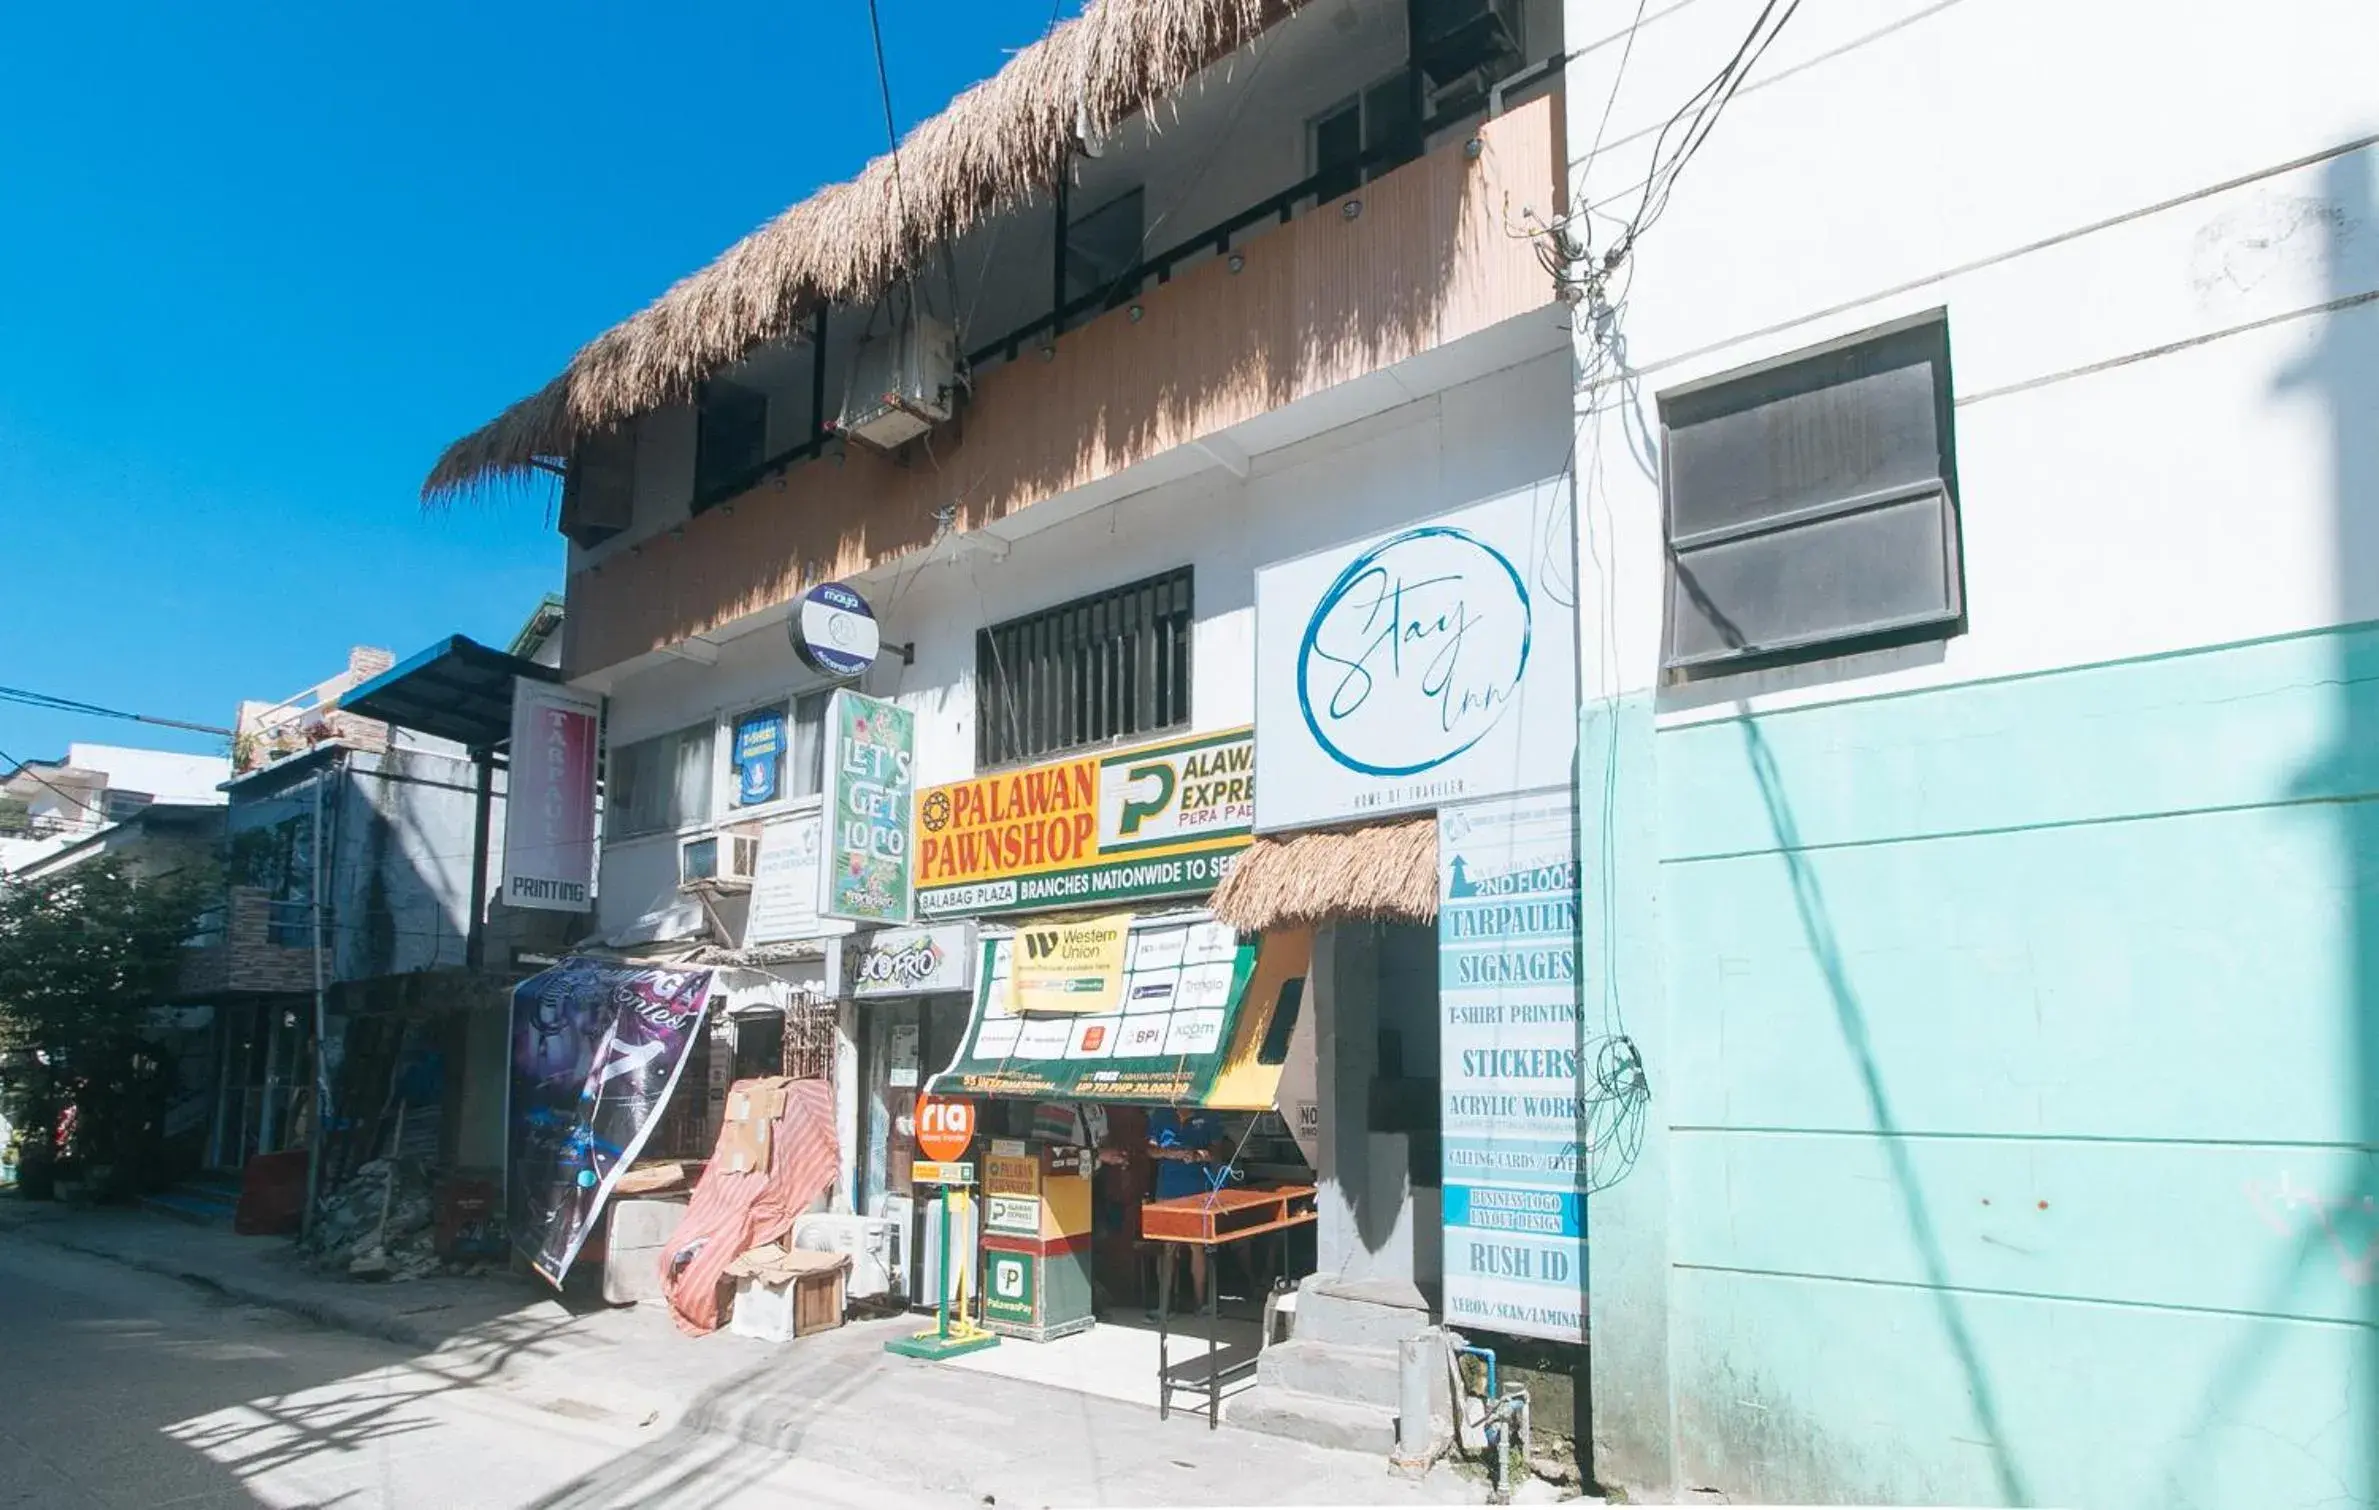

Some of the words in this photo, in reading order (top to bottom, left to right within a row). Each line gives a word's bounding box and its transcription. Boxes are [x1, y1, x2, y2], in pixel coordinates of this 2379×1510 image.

[824, 589, 859, 609] maya
[1314, 567, 1482, 719] Stay
[1443, 672, 1510, 732] Inn
[842, 736, 910, 786] LET'S
[1181, 745, 1253, 782] ALAW
[848, 783, 902, 822] GET
[952, 760, 1096, 829] PALAWAN
[1178, 809, 1218, 827] PERA
[843, 820, 905, 864] LOCO
[920, 812, 1096, 881] PAWNSHOP
[512, 876, 585, 903] PRINTING
[922, 889, 974, 910] BALABAG
[977, 886, 1014, 906] PLAZA
[1020, 879, 1090, 901] BRANCHES
[1092, 861, 1182, 893] NATIONWIDE
[1185, 863, 1207, 881] TO
[1475, 872, 1514, 897] 2ND
[1518, 862, 1577, 893] FLOOR
[1449, 900, 1580, 937] TARPAULIN
[1061, 945, 1101, 959] Union
[1062, 928, 1118, 944] Western
[1459, 950, 1575, 984] SIGNAGES
[1448, 1004, 1506, 1025] T-SHIRT
[1510, 1002, 1585, 1023] PRINTING
[1136, 1029, 1160, 1043] BPI
[1463, 1046, 1578, 1079] STICKERS
[921, 1103, 968, 1133] ria
[1449, 1094, 1517, 1117] ACRYLIC
[1523, 1096, 1585, 1120] WORKS
[1449, 1149, 1494, 1168] CALLING
[1471, 1190, 1524, 1208] BUSINESS
[1527, 1193, 1561, 1210] LOGO
[1471, 1210, 1514, 1228] LAYOUT
[1516, 1212, 1561, 1231] DESIGN
[1469, 1242, 1532, 1279] RUSH
[1541, 1250, 1569, 1283] ID
